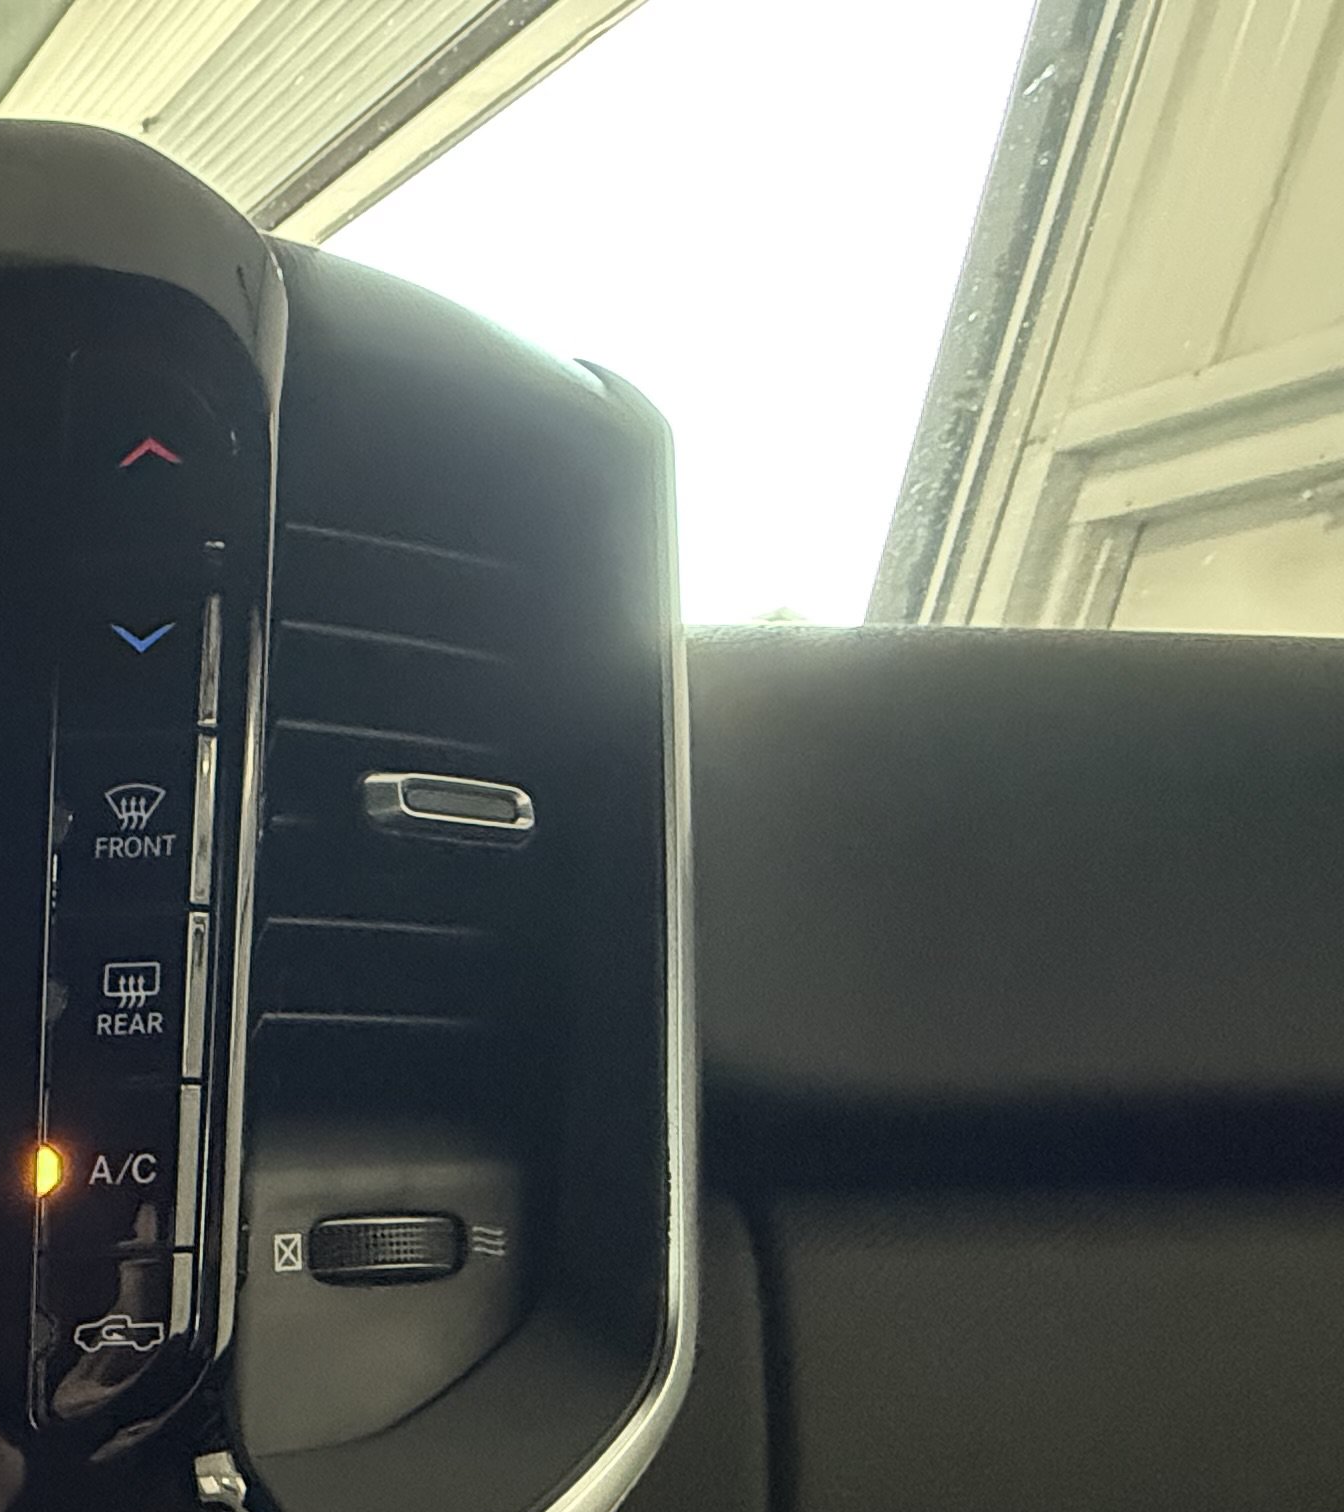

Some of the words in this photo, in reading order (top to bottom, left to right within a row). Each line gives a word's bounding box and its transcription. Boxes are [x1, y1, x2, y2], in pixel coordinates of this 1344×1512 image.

[94, 834, 177, 860] FRONT
[96, 1013, 164, 1037] REAR
[88, 1152, 158, 1186] A/C
